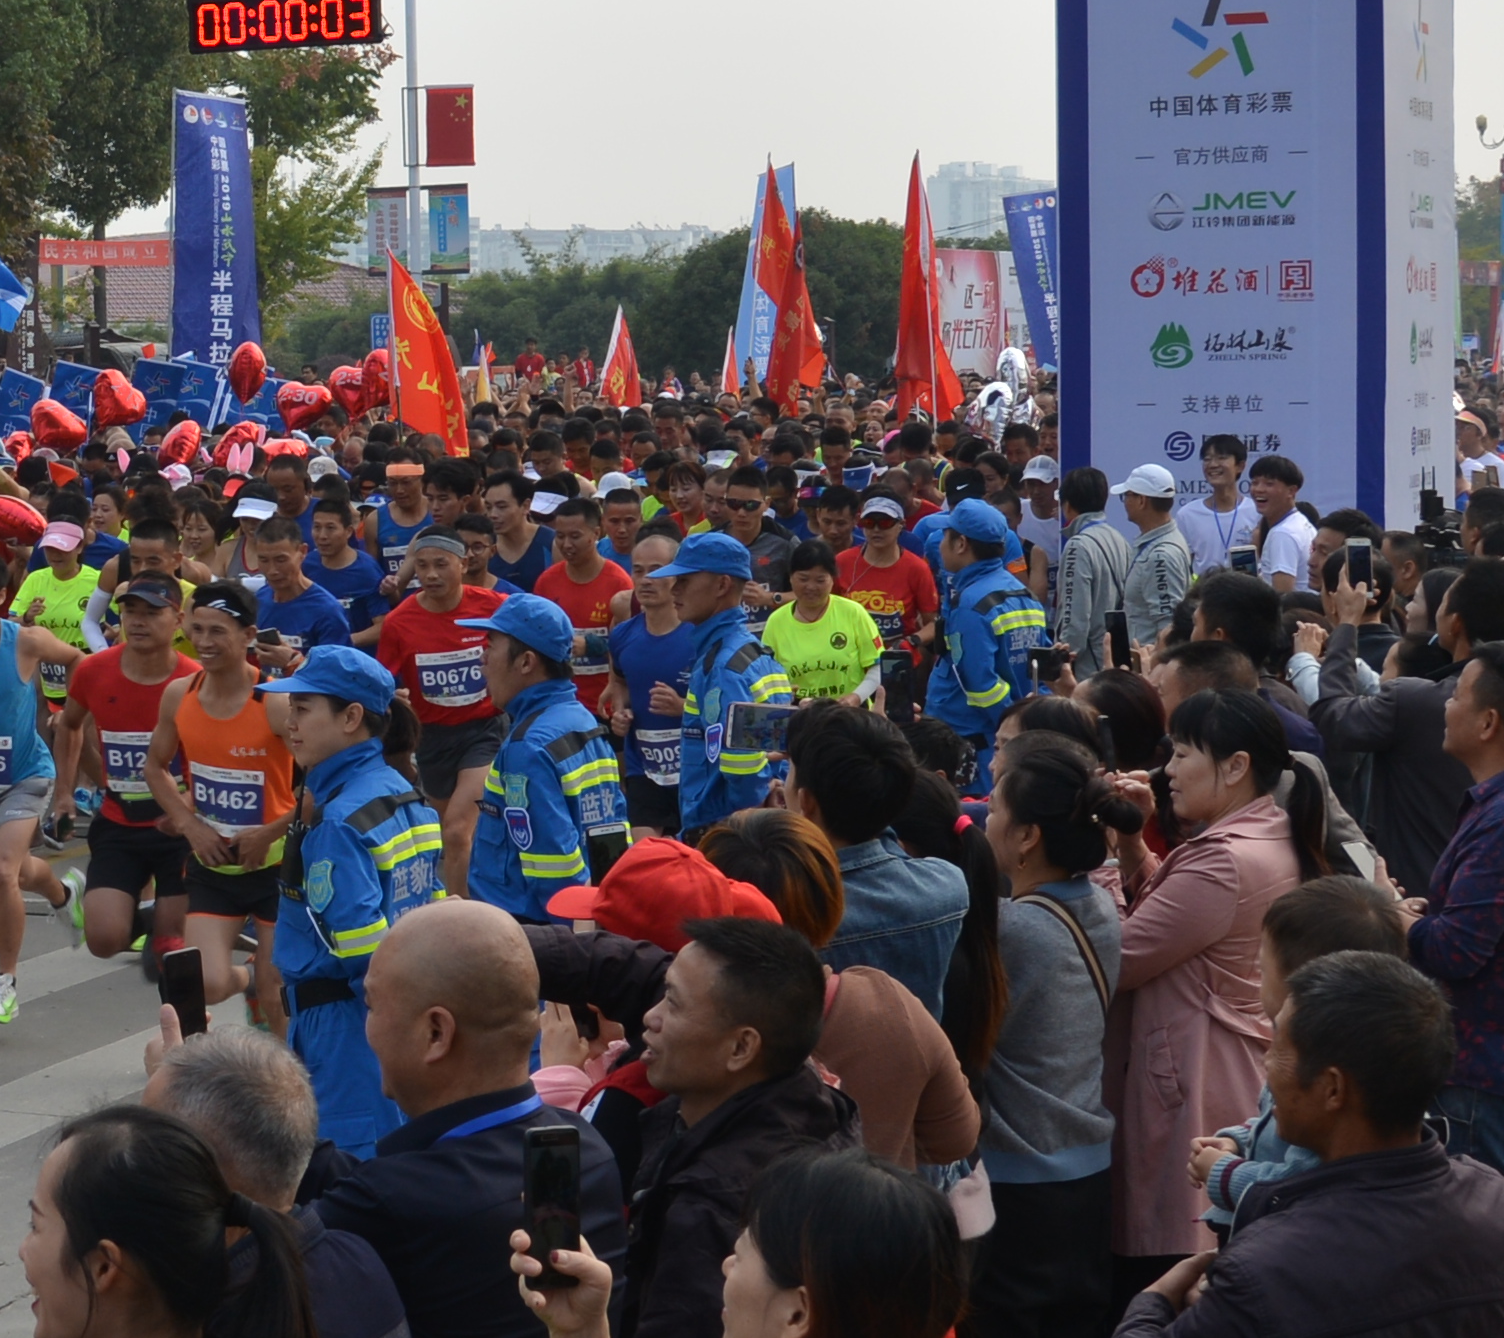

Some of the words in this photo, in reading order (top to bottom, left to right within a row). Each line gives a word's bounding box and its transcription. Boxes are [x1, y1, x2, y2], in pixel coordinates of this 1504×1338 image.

[1149, 90, 1294, 119] 中国体育彩票
[1173, 144, 1270, 167] 官方供应商
[1192, 190, 1297, 211] JMEV
[1171, 266, 1260, 297] 堆花酒
[278, 387, 319, 406] 2:30
[1181, 394, 1264, 414] 支持单位
[422, 664, 483, 687] B0676
[194, 781, 258, 810] B1462
